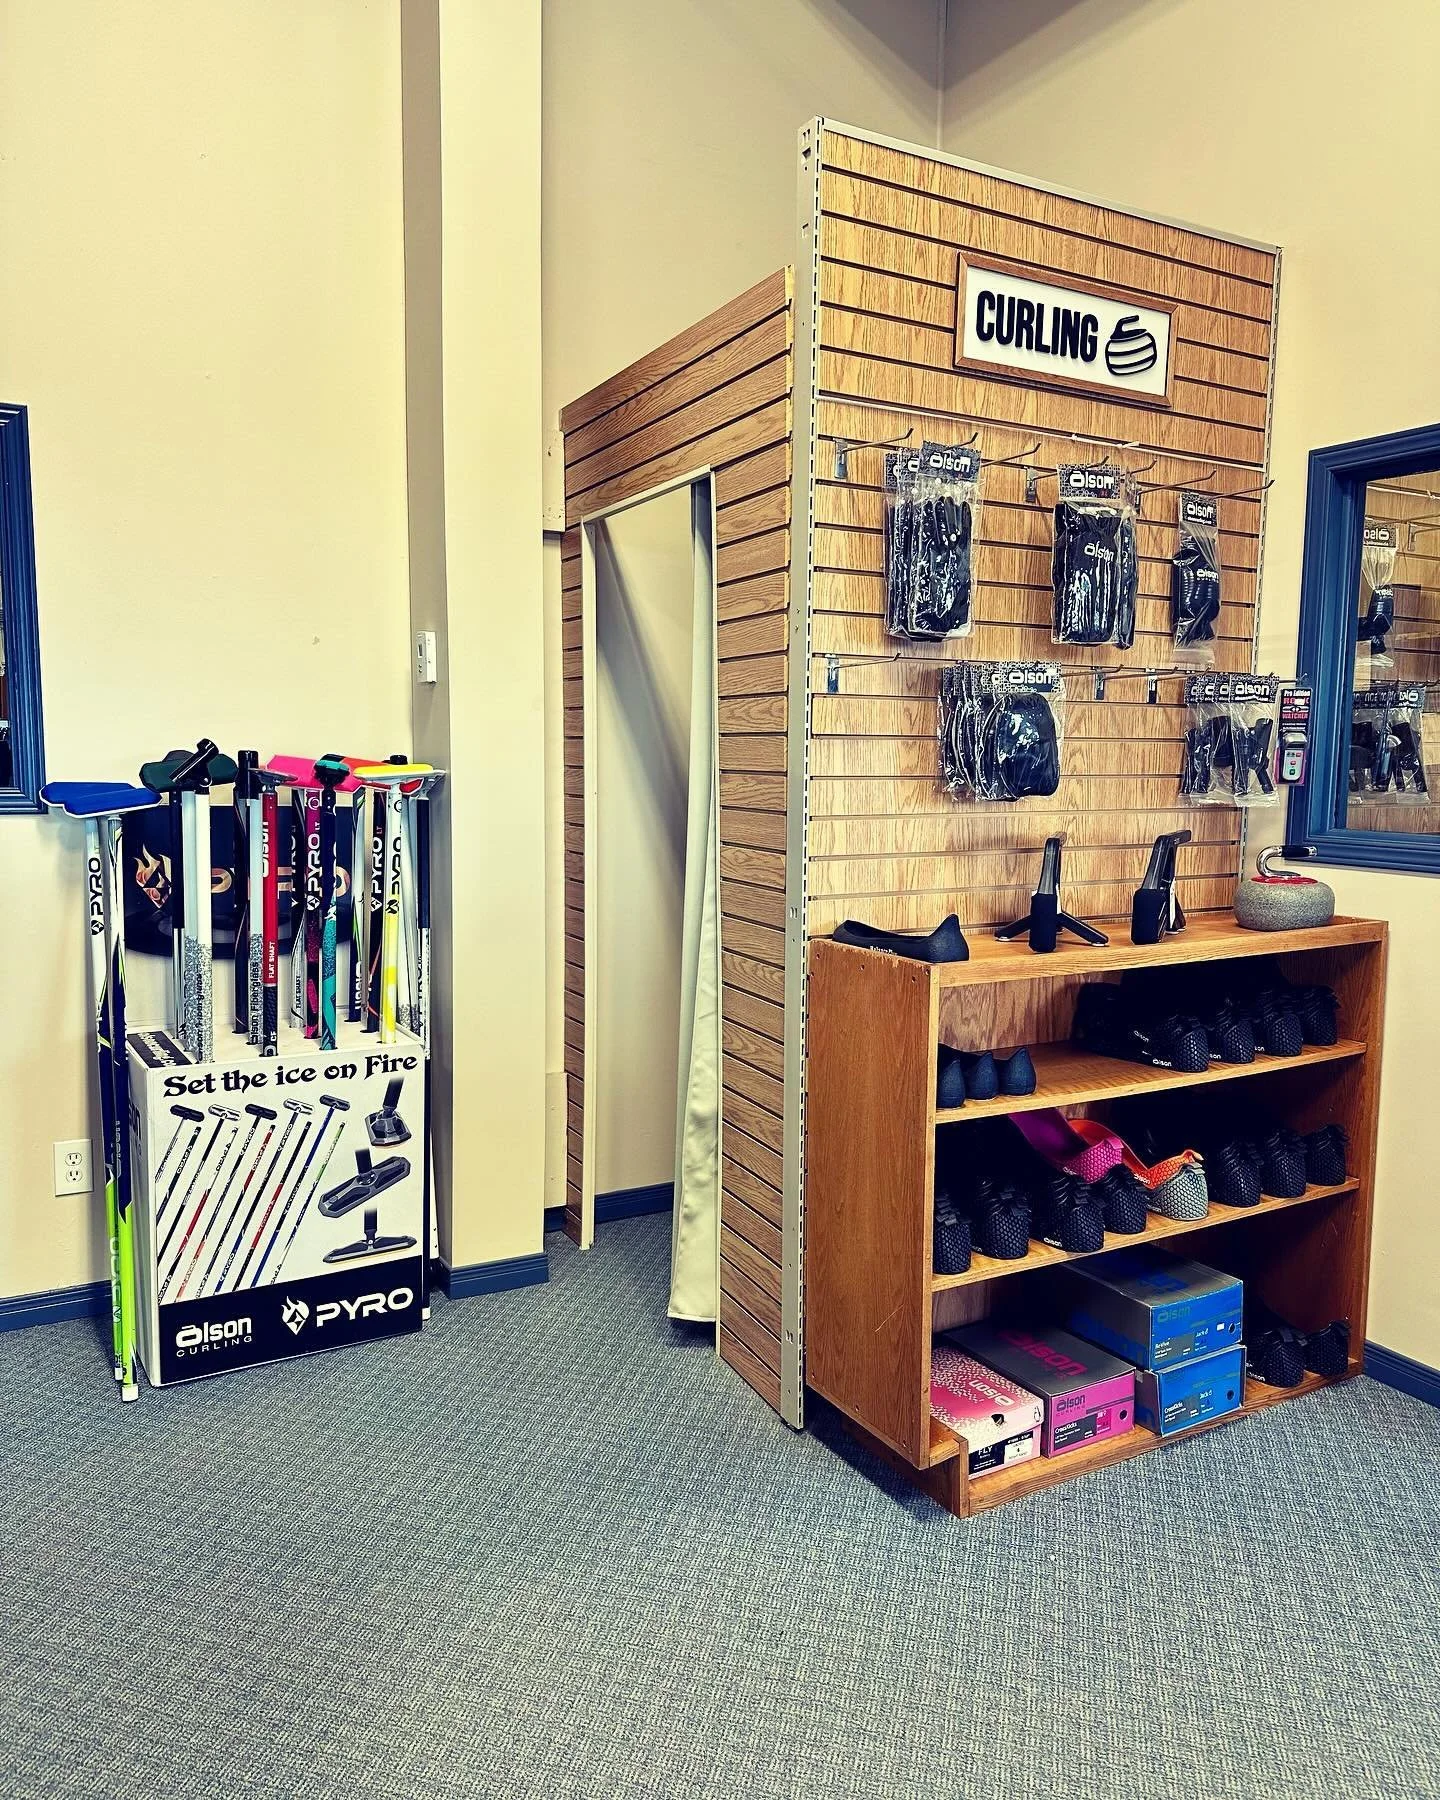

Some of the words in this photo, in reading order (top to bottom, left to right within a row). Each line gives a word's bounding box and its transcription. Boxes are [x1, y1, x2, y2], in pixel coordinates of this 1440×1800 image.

[976, 290, 1099, 363] CURLING
[308, 833, 321, 892] PYRO
[371, 836, 383, 894] PYRO
[88, 857, 104, 916] PYRO
[268, 941, 276, 962] SHAFT
[268, 963, 276, 979] FLAT
[163, 1074, 217, 1098] Set
[221, 1065, 268, 1094] the
[275, 1063, 317, 1086] ice
[324, 1060, 358, 1080] on
[364, 1054, 419, 1081] Fire
[316, 1287, 415, 1328] PYRO
[176, 1335, 252, 1357] CURLING
